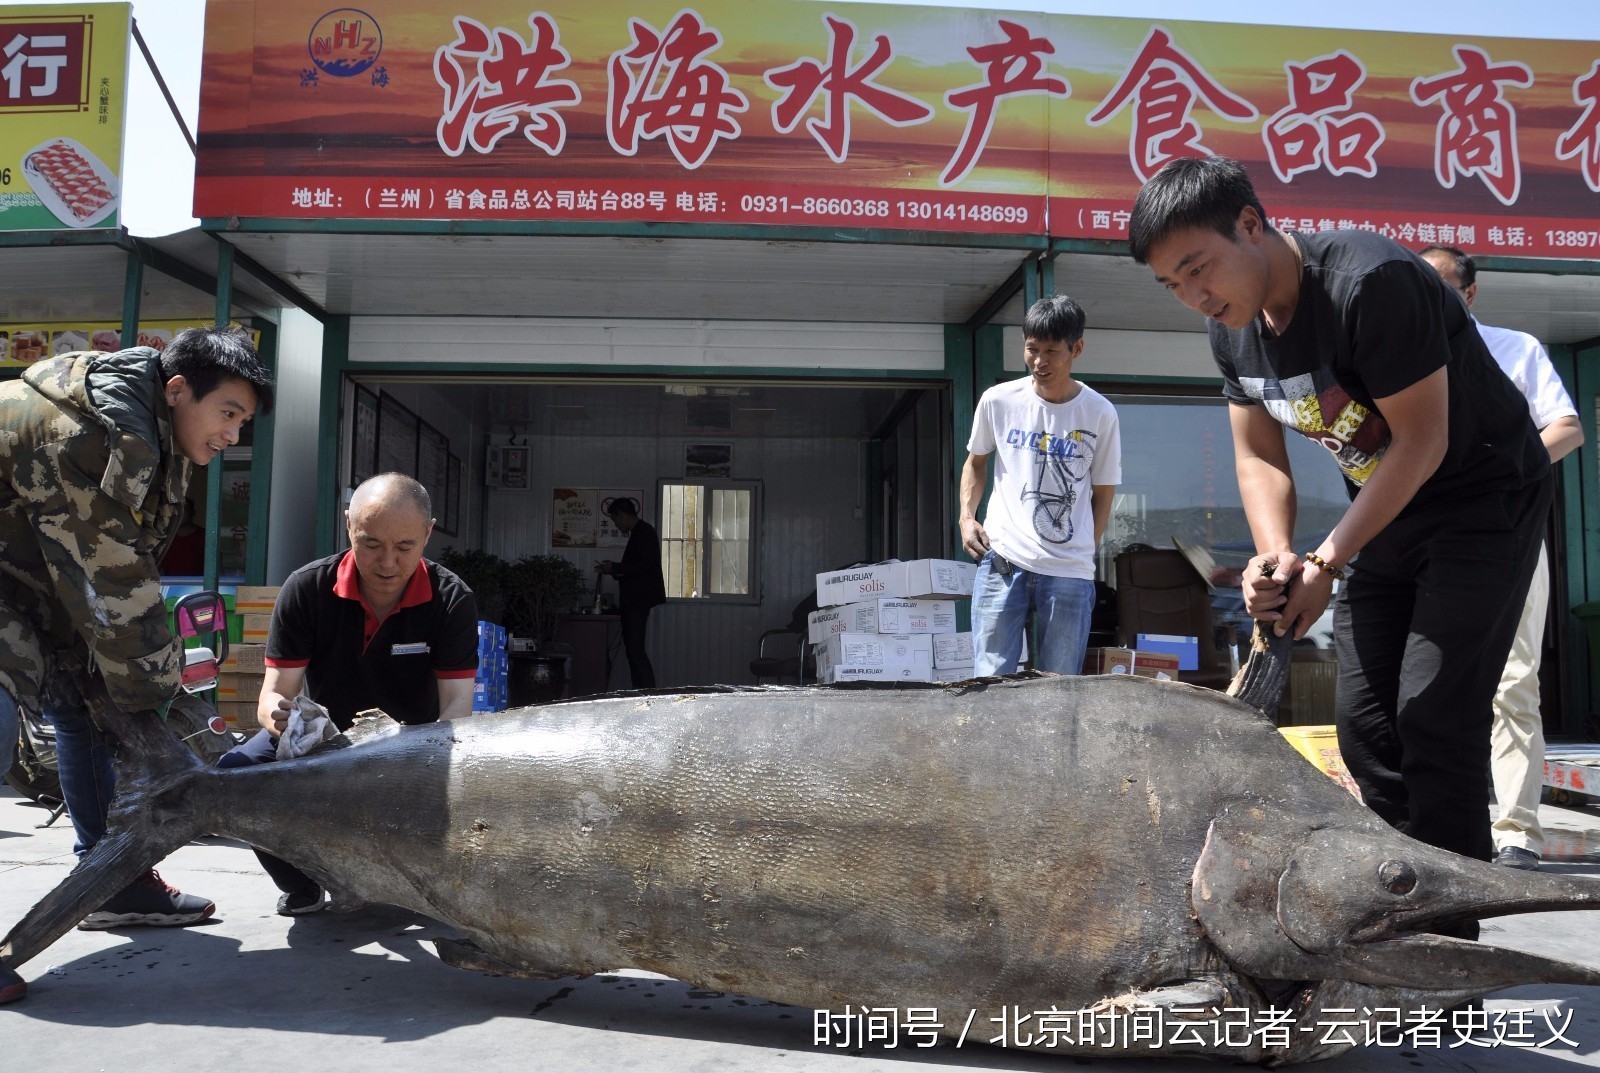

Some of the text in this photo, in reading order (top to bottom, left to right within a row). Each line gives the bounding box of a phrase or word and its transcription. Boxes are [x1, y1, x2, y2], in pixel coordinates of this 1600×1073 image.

[1, 33, 68, 99] 行
[371, 66, 391, 88] 海
[0, 167, 12, 186] 6
[896, 201, 1029, 224] 13014148699
[839, 572, 874, 583] URUGUAY
